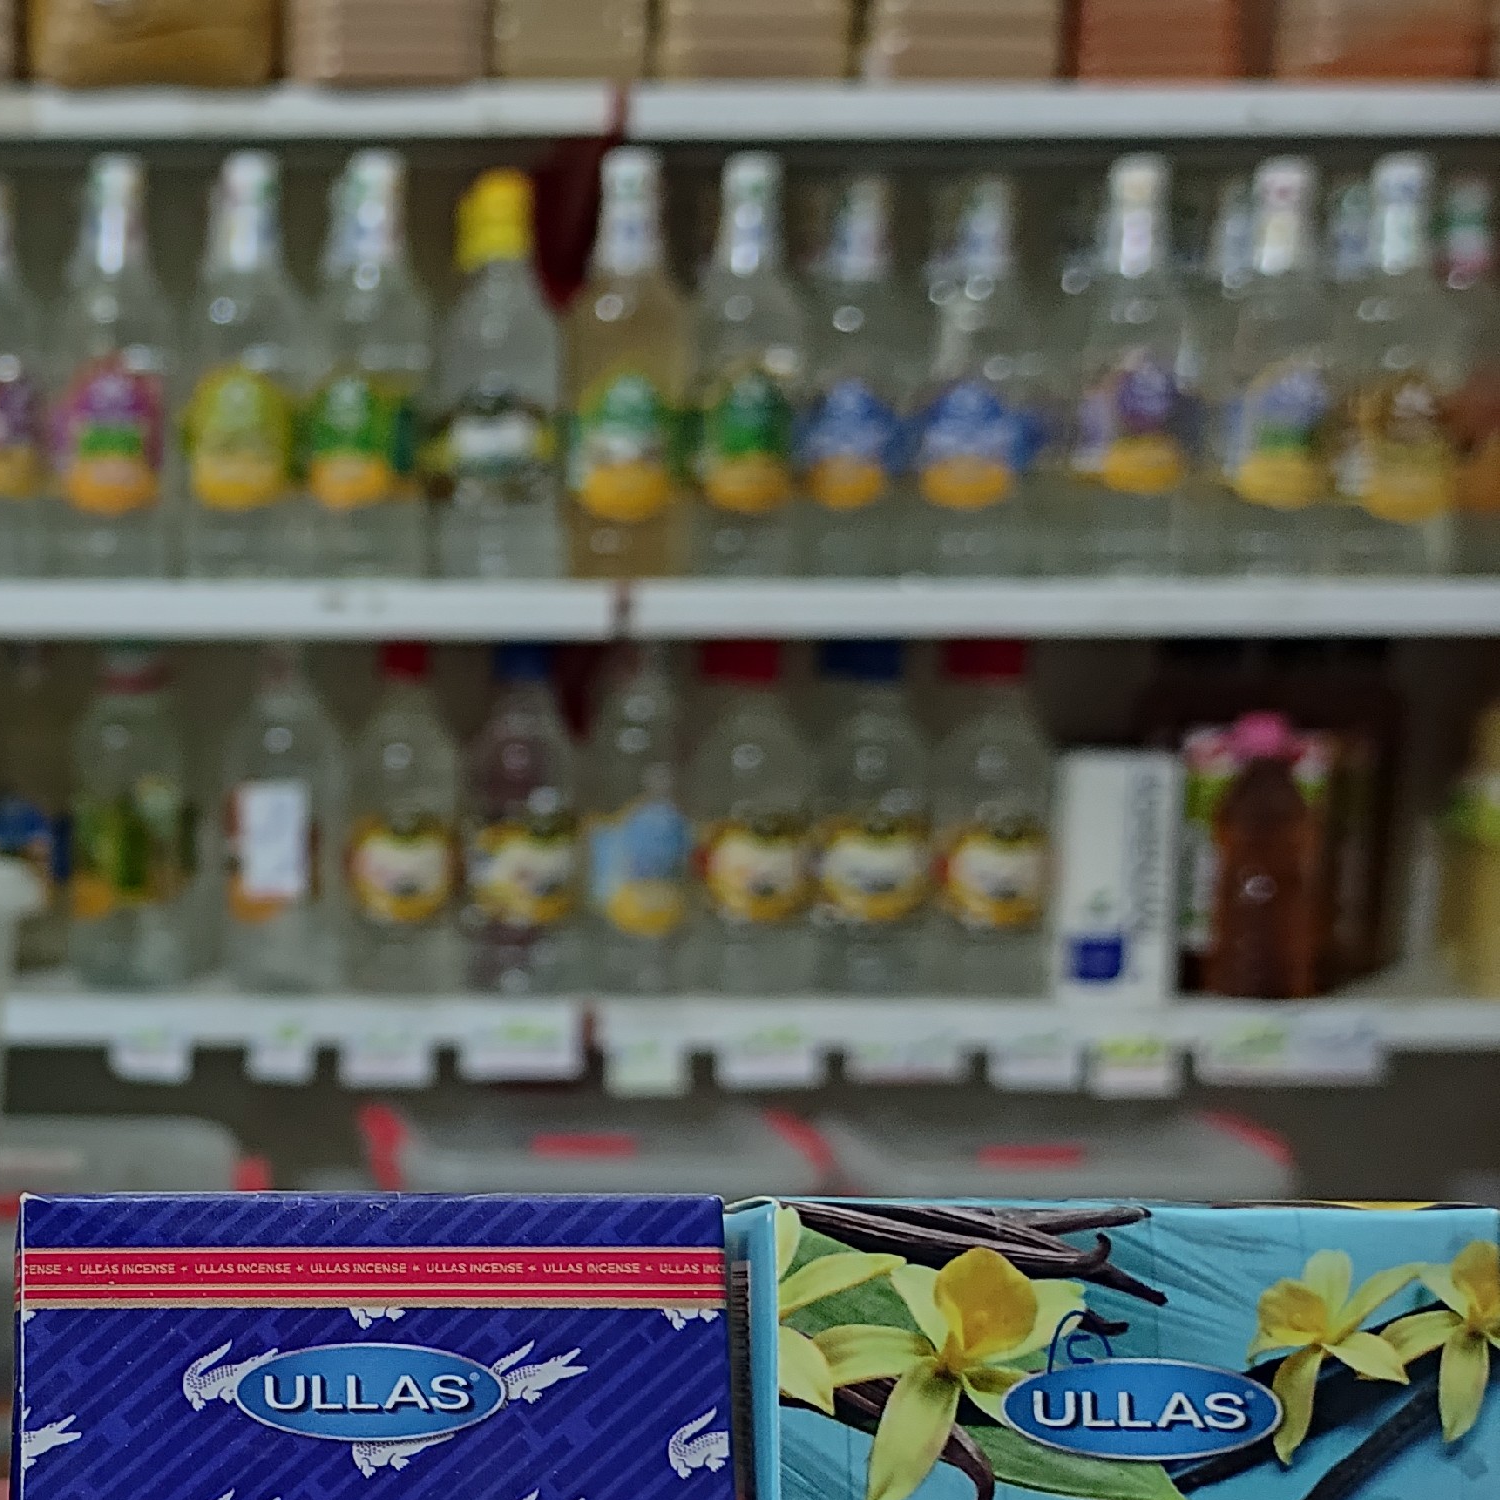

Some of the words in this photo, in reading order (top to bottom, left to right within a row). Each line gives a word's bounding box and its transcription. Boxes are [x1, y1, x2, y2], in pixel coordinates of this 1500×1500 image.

[79, 1263, 119, 1275] ULLAS
[122, 1263, 176, 1275] INCENSE
[194, 1263, 235, 1275] ULLAS
[237, 1263, 291, 1275] INCENSE
[310, 1263, 350, 1275] ULLAS
[353, 1263, 407, 1275] INCENSE
[426, 1262, 466, 1275] ULLAS
[470, 1262, 523, 1275] INCENSE
[542, 1262, 583, 1274] ULLAS
[586, 1262, 641, 1274] INCENSE
[659, 1262, 699, 1274] ULLAS
[263, 1371, 474, 1412] ULLAS
[1032, 1389, 1248, 1430] ULLAS
